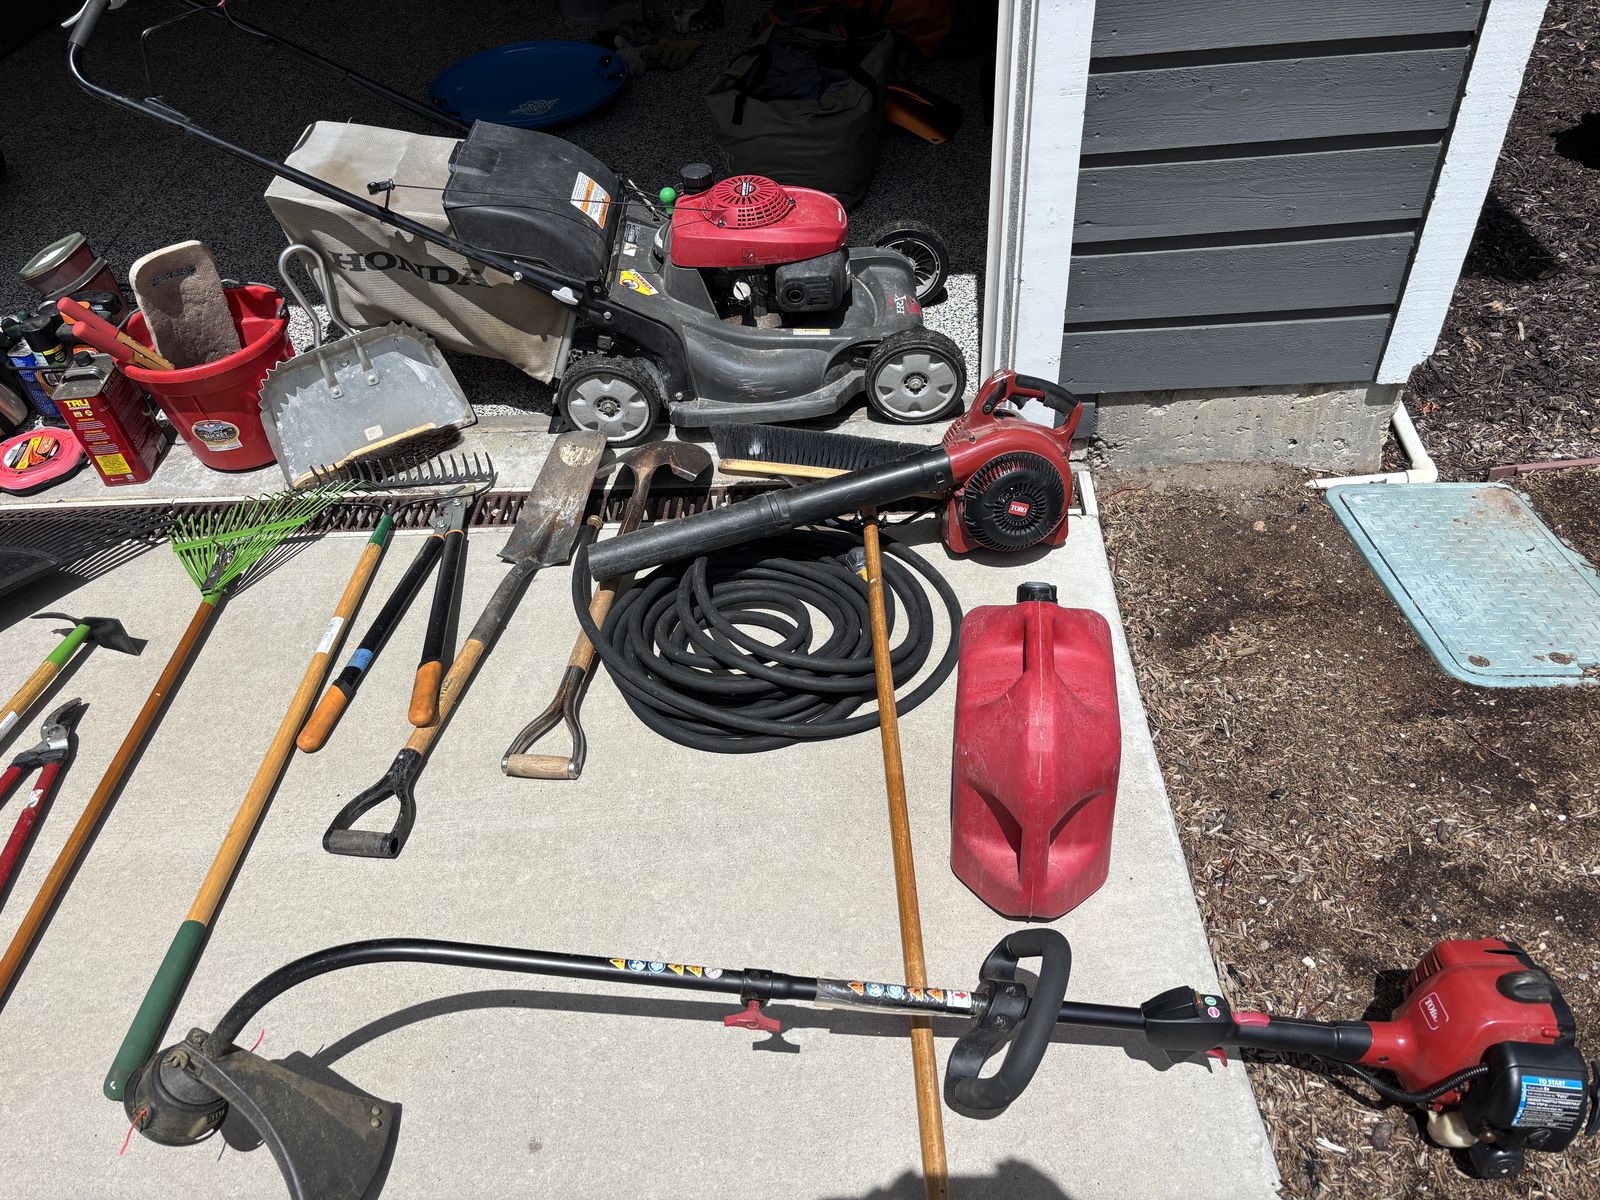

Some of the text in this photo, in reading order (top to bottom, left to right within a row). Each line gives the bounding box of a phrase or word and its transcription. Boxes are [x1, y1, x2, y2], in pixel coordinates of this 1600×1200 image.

[327, 250, 493, 289] HONDA
[63, 399, 90, 407] TRU
[1010, 504, 1028, 513] TORO
[1538, 1078, 1566, 1087] TO START
